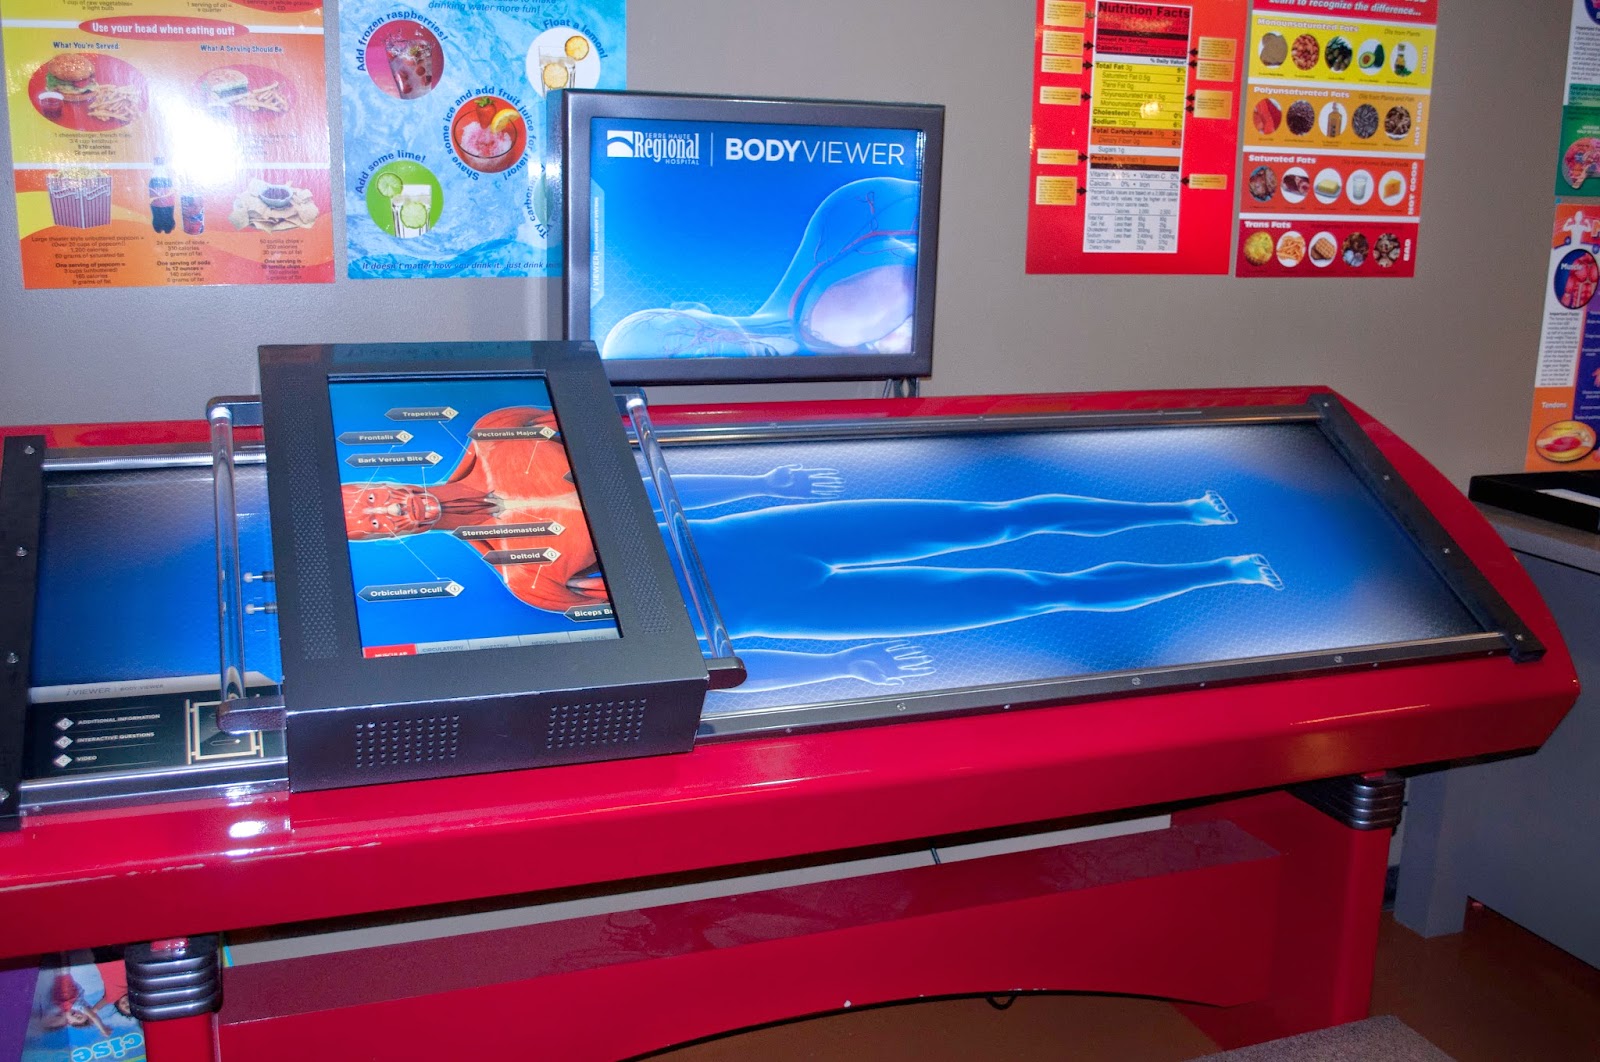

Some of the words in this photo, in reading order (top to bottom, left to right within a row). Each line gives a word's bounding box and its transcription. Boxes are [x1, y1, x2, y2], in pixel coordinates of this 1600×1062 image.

[428, 1, 465, 11] drinking
[469, 3, 494, 11] water
[496, 5, 519, 13] more
[522, 5, 540, 14] fun!
[1099, 2, 1152, 16] Nutrition
[1156, 6, 1190, 19] Facts
[1309, 0, 1351, 11] recognize
[1354, 2, 1368, 12] the
[92, 22, 109, 32] Use
[111, 24, 132, 34] your
[135, 23, 157, 33] head
[160, 24, 184, 34] when
[186, 26, 215, 36] eating
[217, 26, 235, 36] out!
[358, 17, 385, 45] frozen
[386, 10, 449, 41] raspberries!
[1257, 18, 1337, 31] Monounsaturated
[543, 18, 570, 29] Float
[581, 24, 609, 59] lemon!
[356, 48, 366, 71] Add
[475, 86, 494, 95] add
[498, 88, 520, 106] fruit
[1254, 86, 1328, 98] Polyunsaturated
[455, 90, 473, 106] and
[443, 106, 455, 122] ice
[518, 105, 534, 131] juice
[443, 125, 453, 154] some
[634, 131, 700, 163] Regional
[1248, 154, 1294, 163] Saturated
[355, 171, 369, 194] Add
[368, 152, 394, 171] some
[397, 150, 426, 163] lime!
[452, 157, 480, 180] Shave
[535, 223, 547, 239] Try
[523, 261, 543, 269] drink
[402, 410, 440, 419] Trapezius
[359, 433, 394, 441] Frontalis
[516, 430, 537, 438] Major
[358, 456, 376, 464] Bark
[462, 525, 546, 537] Sternocleidomastoid
[510, 551, 541, 561] Deltoid
[370, 588, 418, 597] Orbicularis
[420, 586, 443, 594] Oculi
[574, 609, 602, 618] Biceps
[76, 735, 118, 743] INTERACTIVE
[119, 732, 155, 740] QUESTIONS
